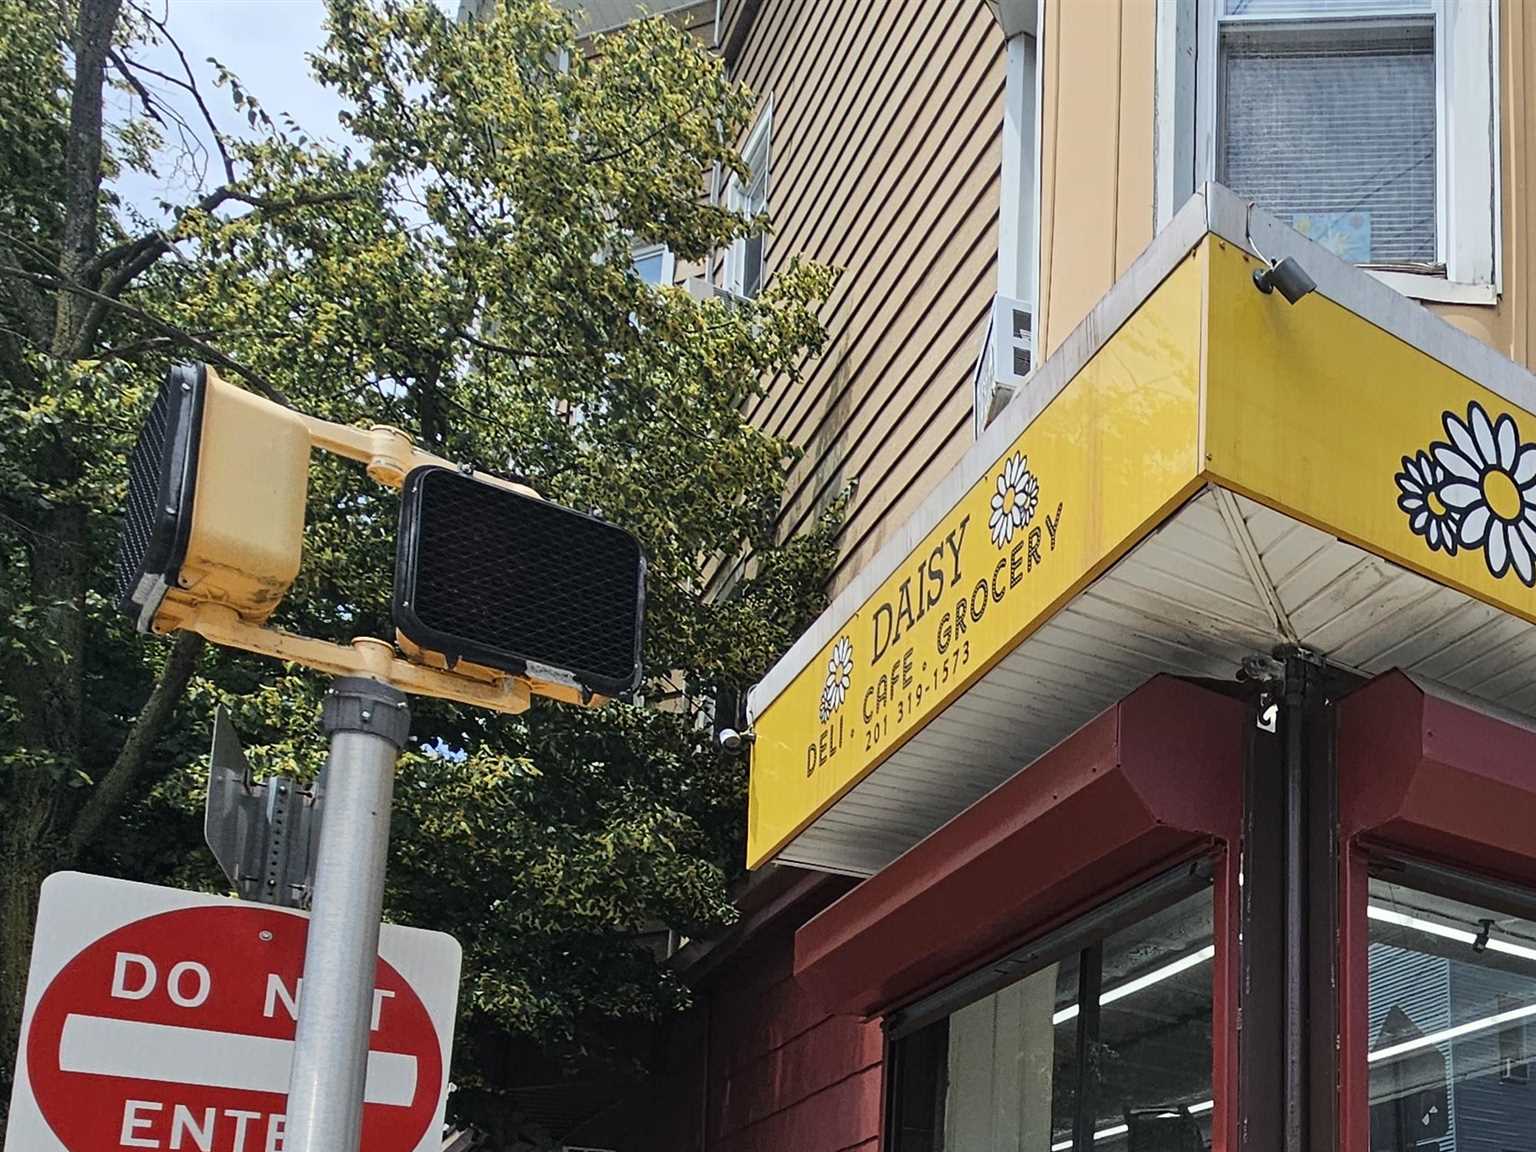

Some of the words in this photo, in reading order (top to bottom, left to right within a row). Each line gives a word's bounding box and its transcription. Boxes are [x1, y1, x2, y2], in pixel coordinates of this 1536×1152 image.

[807, 715, 844, 778] DELI
[863, 647, 914, 724] CAFE
[937, 501, 1063, 655] GROCERY
[870, 513, 970, 666] DAISY
[865, 714, 887, 752] 201
[897, 640, 969, 724] 319-1573
[110, 951, 211, 1008] DO
[262, 973, 396, 1031] NT
